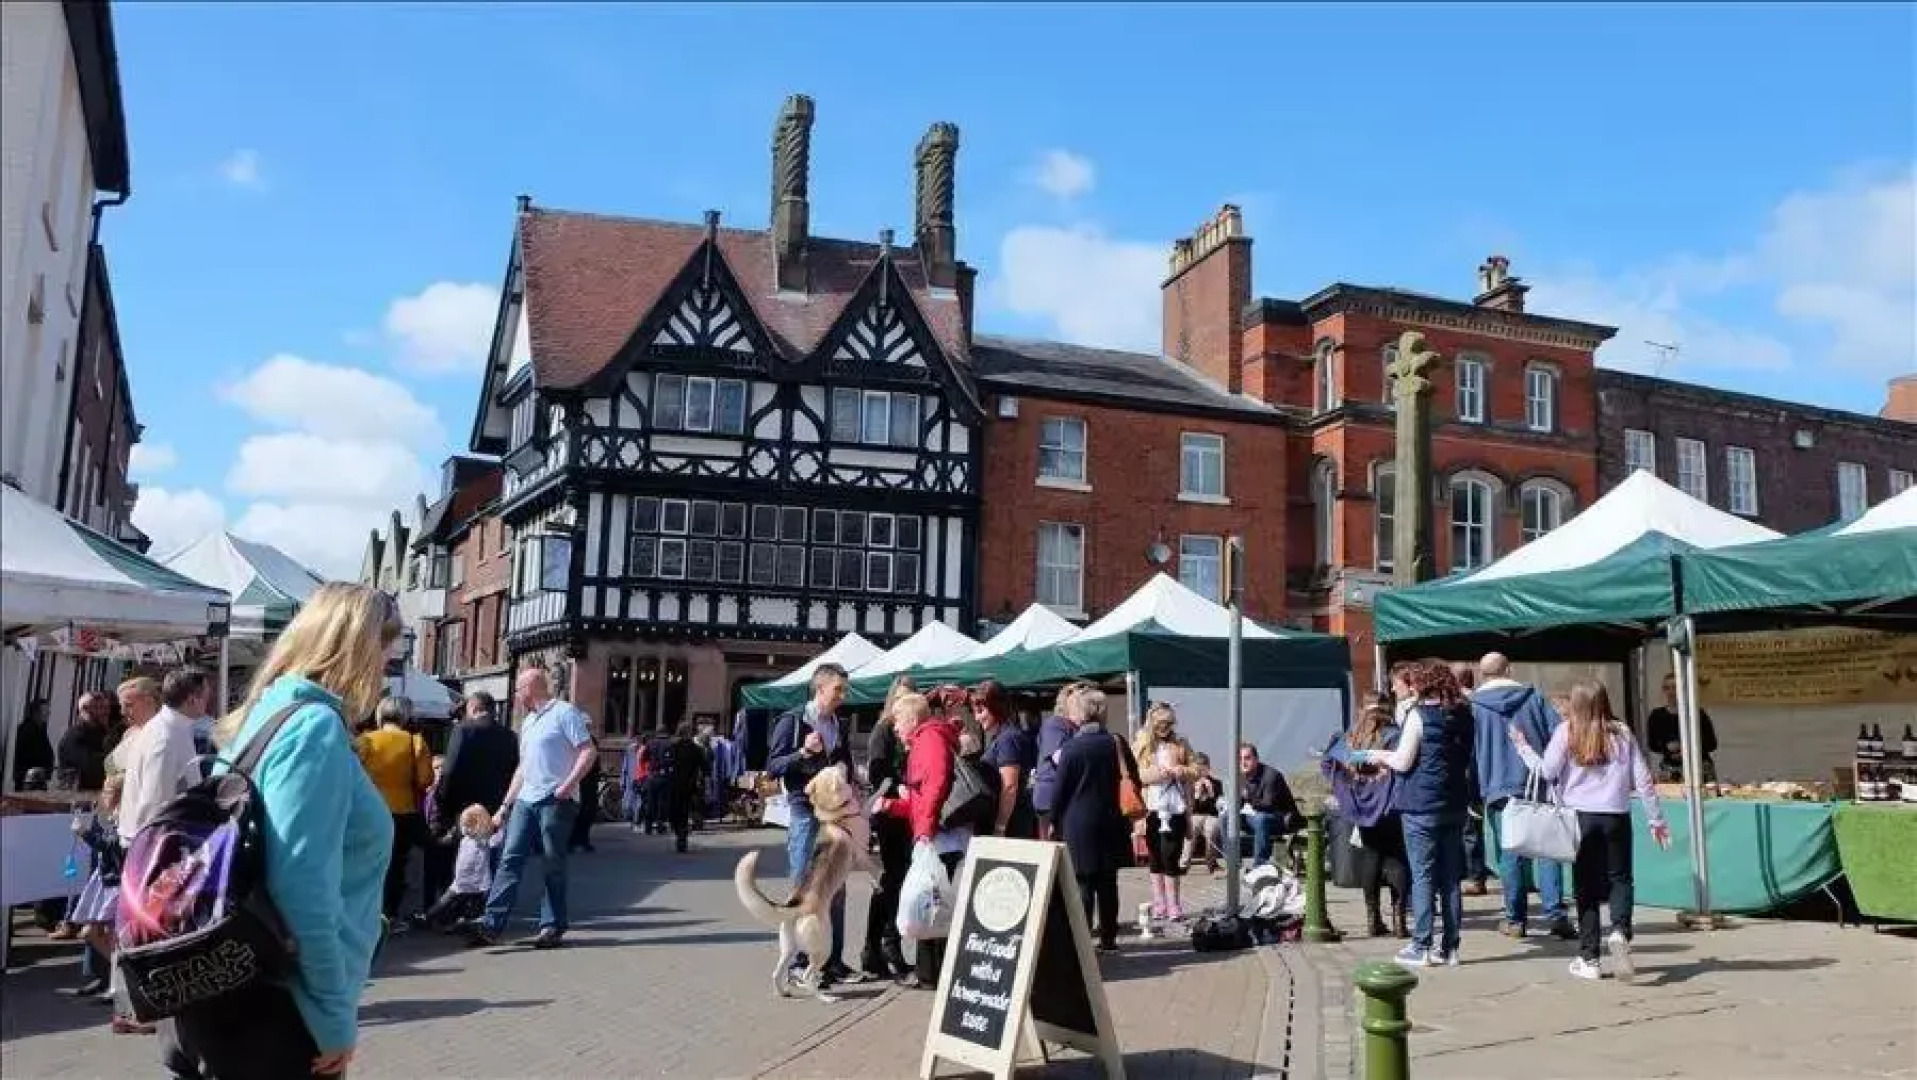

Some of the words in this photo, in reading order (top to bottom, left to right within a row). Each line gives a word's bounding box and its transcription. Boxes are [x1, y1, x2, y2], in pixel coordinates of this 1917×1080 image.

[138, 956, 255, 1013] WARS
[146, 938, 255, 992] STAR
[970, 961, 992, 981] with
[991, 968, 1002, 983] a
